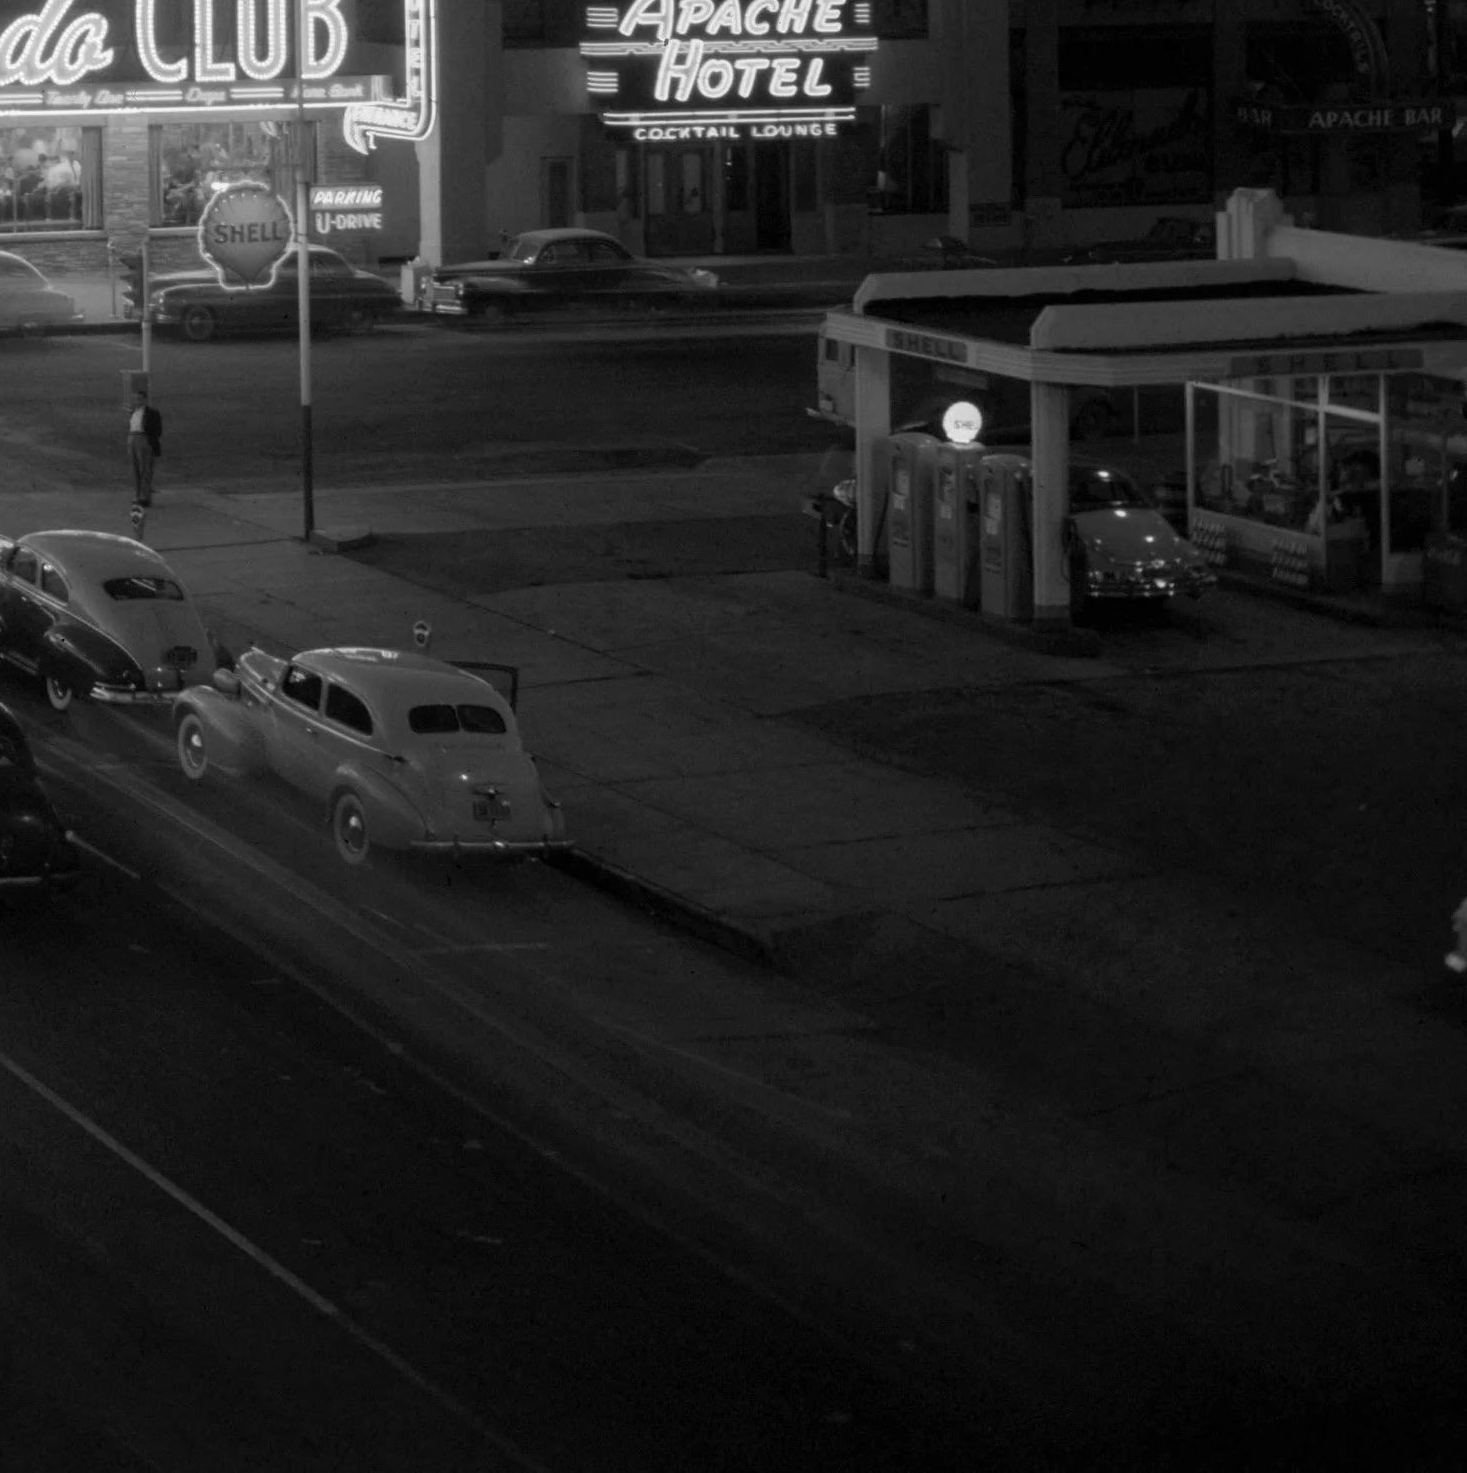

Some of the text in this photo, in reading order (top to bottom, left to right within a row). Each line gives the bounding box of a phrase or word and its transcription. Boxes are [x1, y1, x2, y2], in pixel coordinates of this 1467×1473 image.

[653, 38, 834, 101] HOTEL
[1308, 106, 1442, 129] APACHE BAR
[634, 123, 837, 141] COCKTAIL LOUNGE
[314, 189, 383, 206] PARKING
[213, 222, 283, 245] SHELL
[316, 213, 382, 234] U-DRIVE
[894, 332, 960, 361] SHELL
